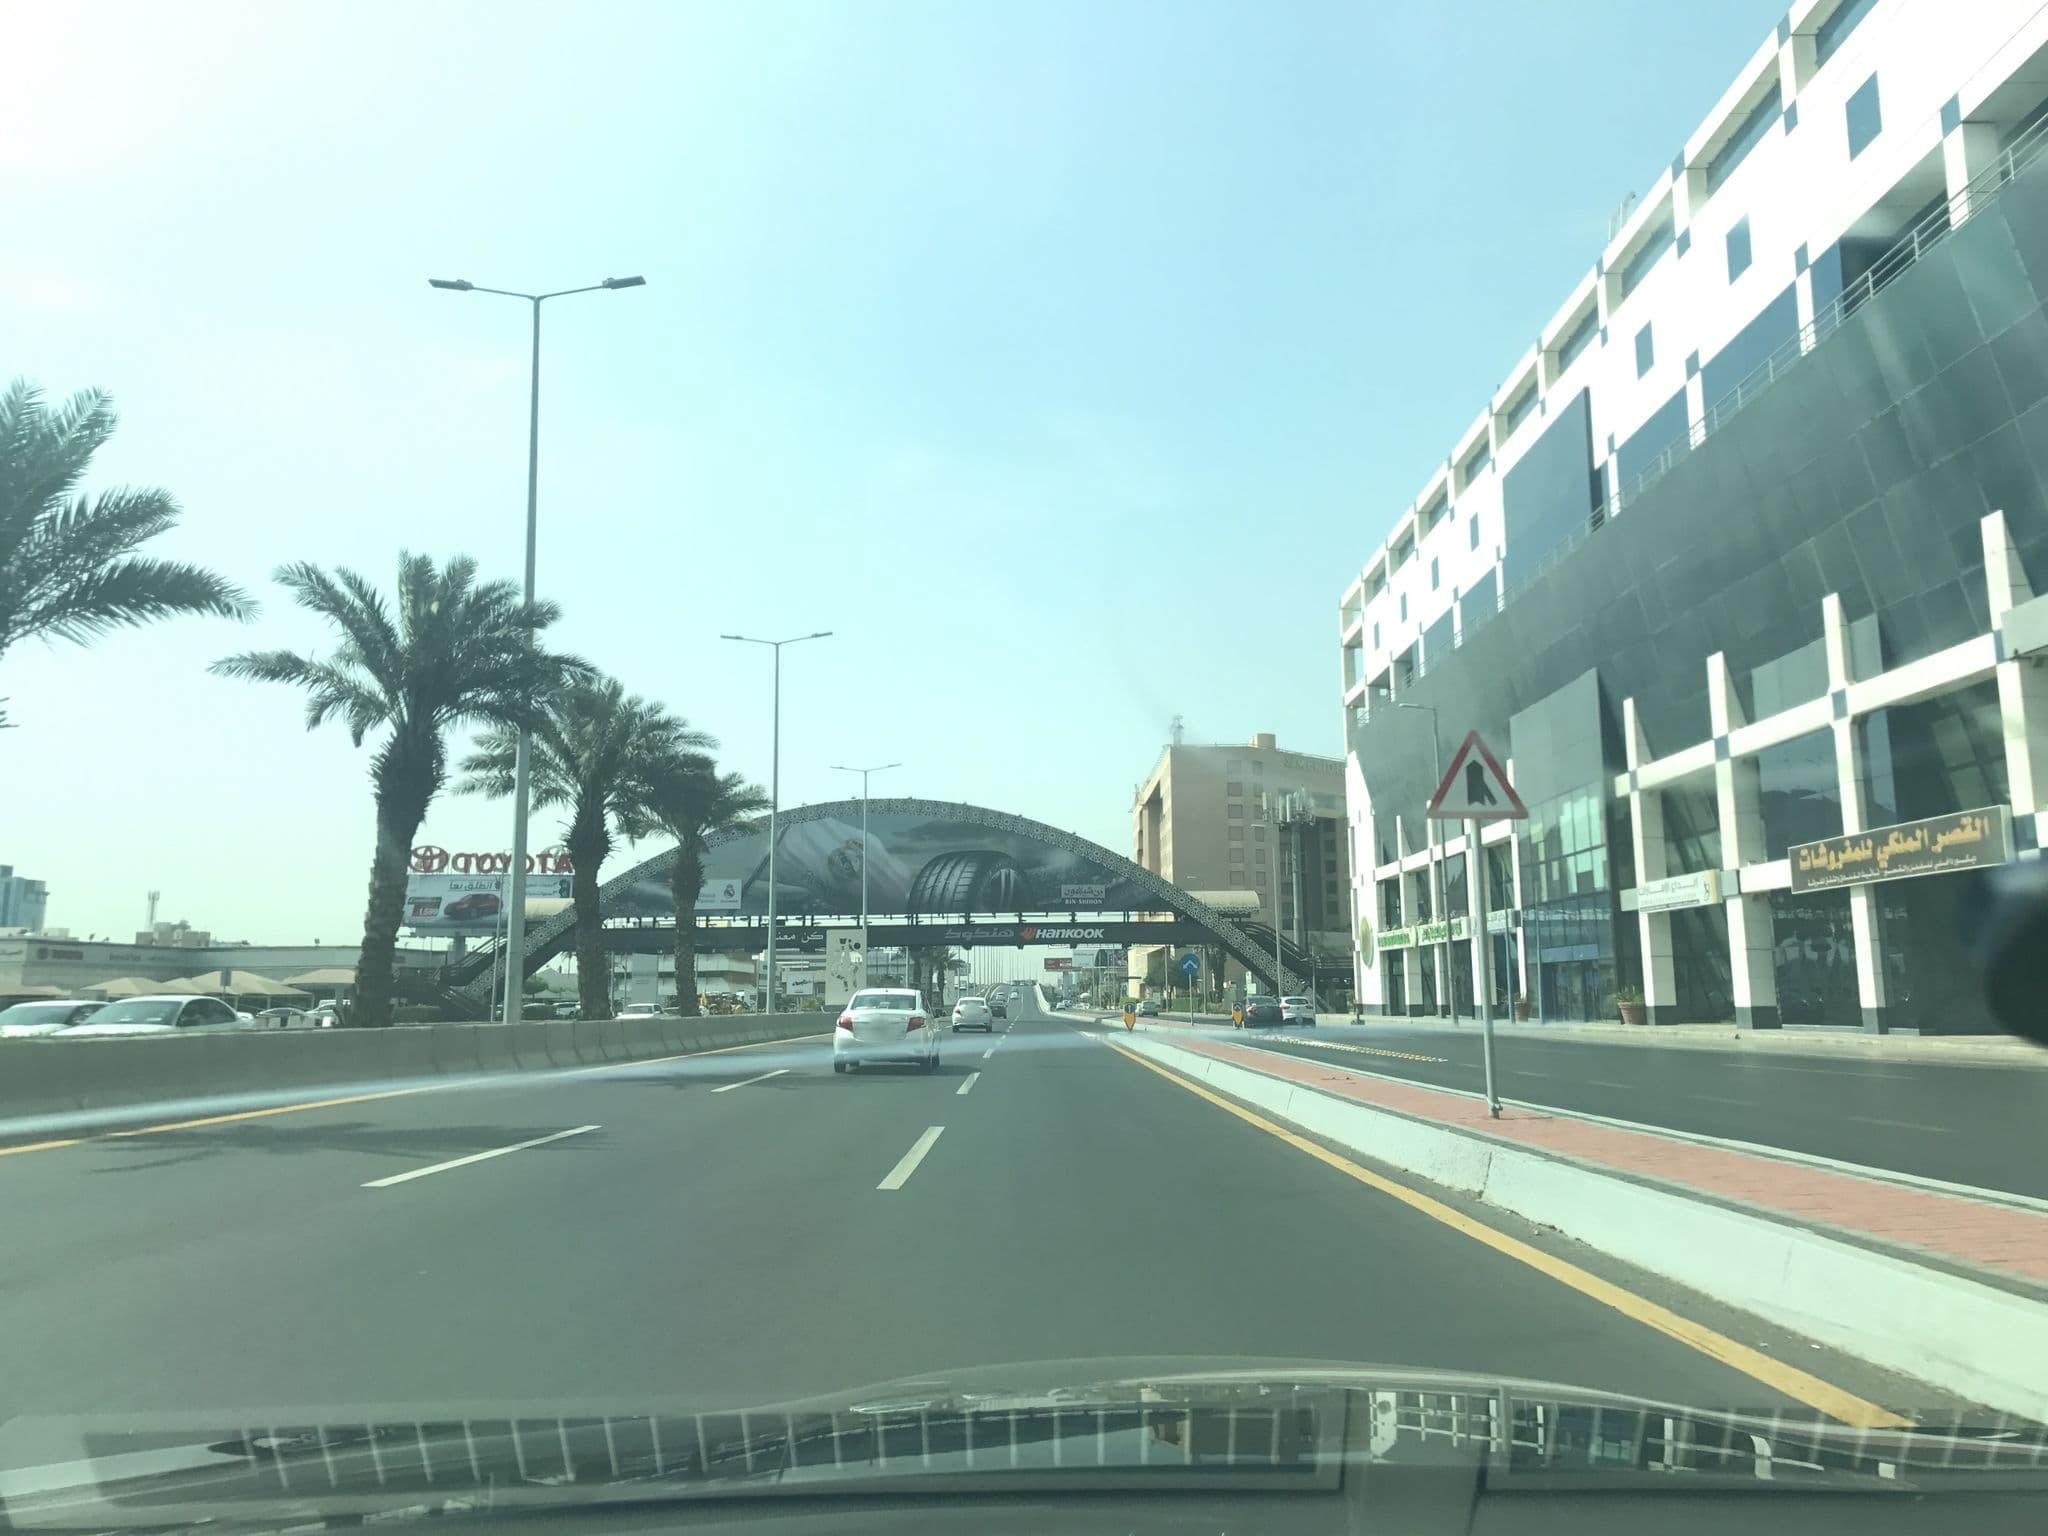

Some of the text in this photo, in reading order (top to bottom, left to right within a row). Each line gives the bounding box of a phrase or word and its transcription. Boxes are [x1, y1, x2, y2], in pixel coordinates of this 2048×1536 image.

[1876, 827, 1929, 869] الملكي
[1931, 815, 1990, 854] القصر
[1798, 837, 1873, 871] للمفروشات
[801, 931, 824, 943] كن
